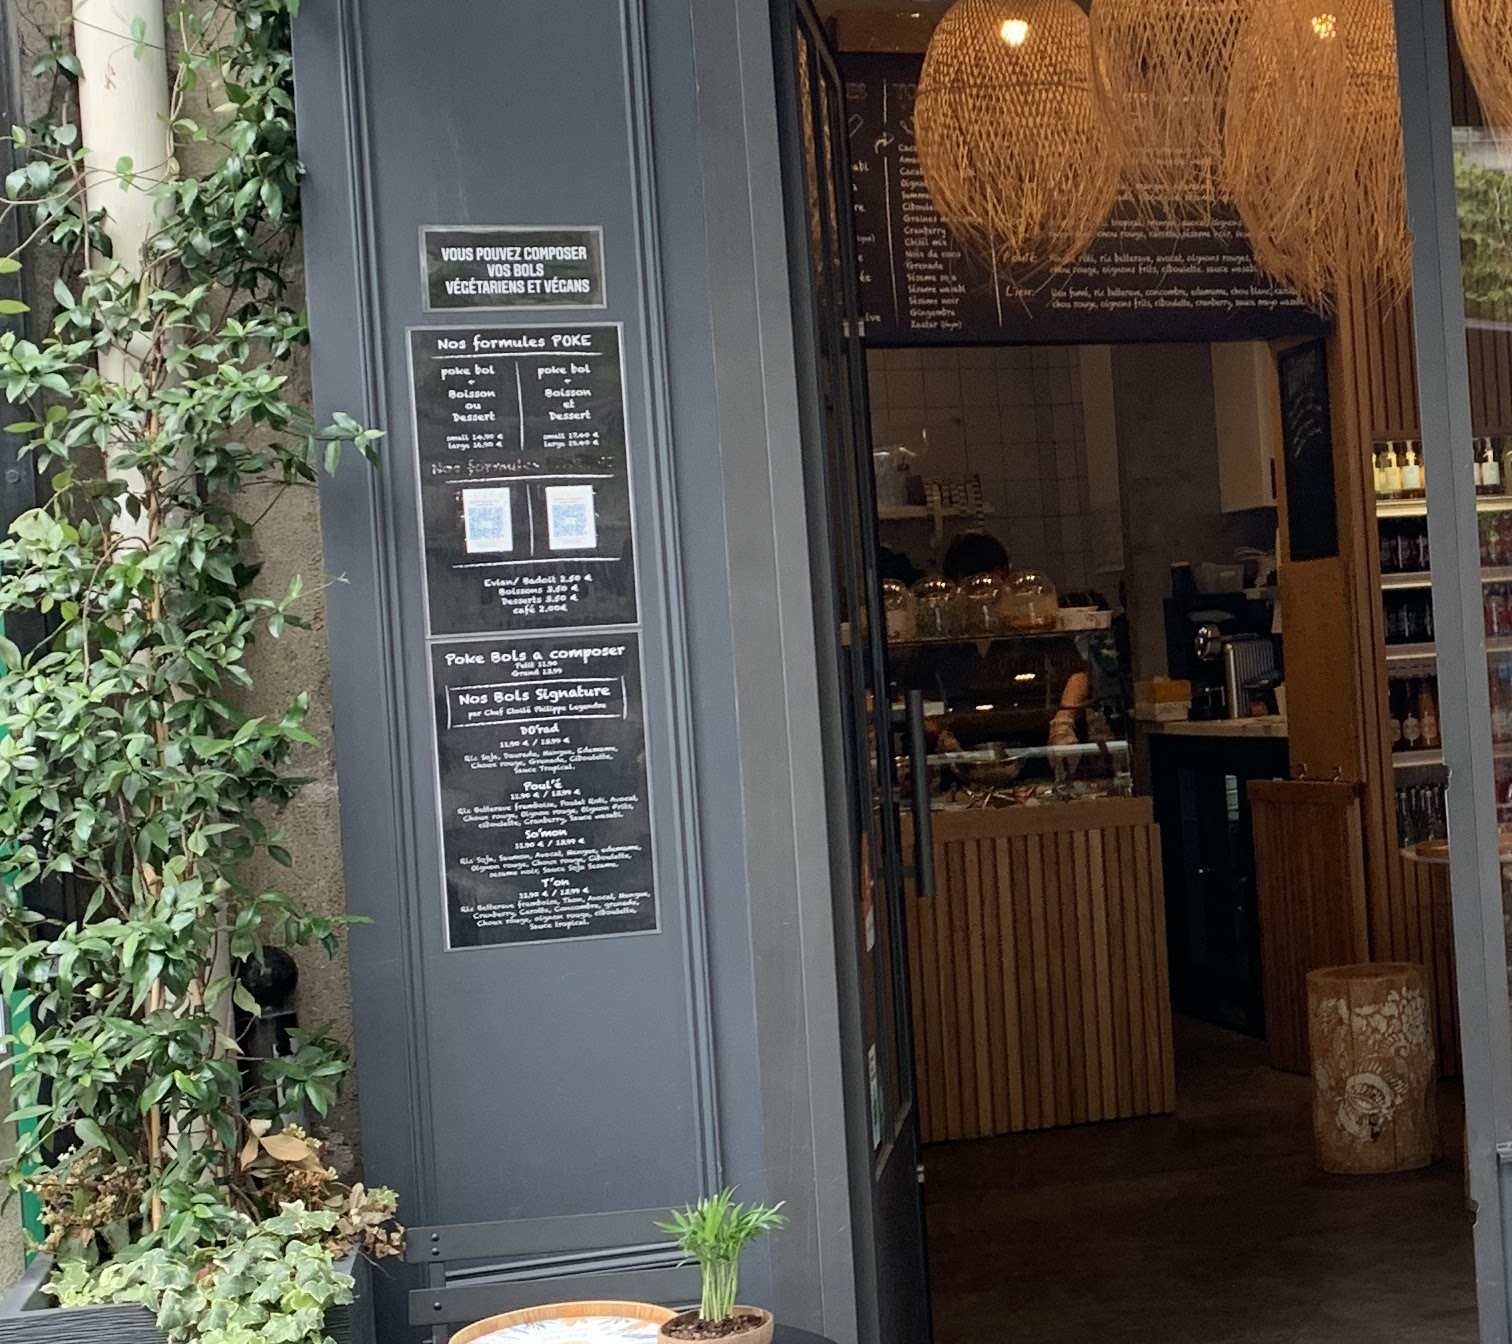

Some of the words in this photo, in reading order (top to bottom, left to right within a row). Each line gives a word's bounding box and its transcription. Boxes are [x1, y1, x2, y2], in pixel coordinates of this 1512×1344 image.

[441, 248, 474, 261] VOUS
[476, 247, 521, 261] POUVEZ
[524, 247, 587, 260] COMPOSER
[487, 264, 511, 277] VOS
[513, 263, 544, 276] BOLS
[445, 277, 525, 294] VÉGÉTARIENS
[527, 280, 541, 293] ET
[544, 276, 590, 293] VÉGANS
[438, 339, 466, 349] Nos
[473, 334, 545, 351] formules
[552, 334, 591, 347] POKE
[441, 367, 471, 380] poke
[475, 364, 495, 375] bol
[538, 366, 567, 379] poke
[571, 363, 591, 374] bol
[449, 390, 495, 399] Boisson
[545, 388, 591, 398] Boisson
[563, 399, 575, 408] et
[452, 411, 496, 422] Dessert
[549, 410, 591, 421] Dessert
[513, 604, 536, 615] café
[445, 653, 485, 666] Poke
[491, 650, 526, 662] Bols
[550, 646, 625, 664] composer
[459, 694, 487, 705] Nos
[494, 690, 530, 703] Bols
[536, 685, 611, 703] Signature
[484, 708, 503, 716] Chef
